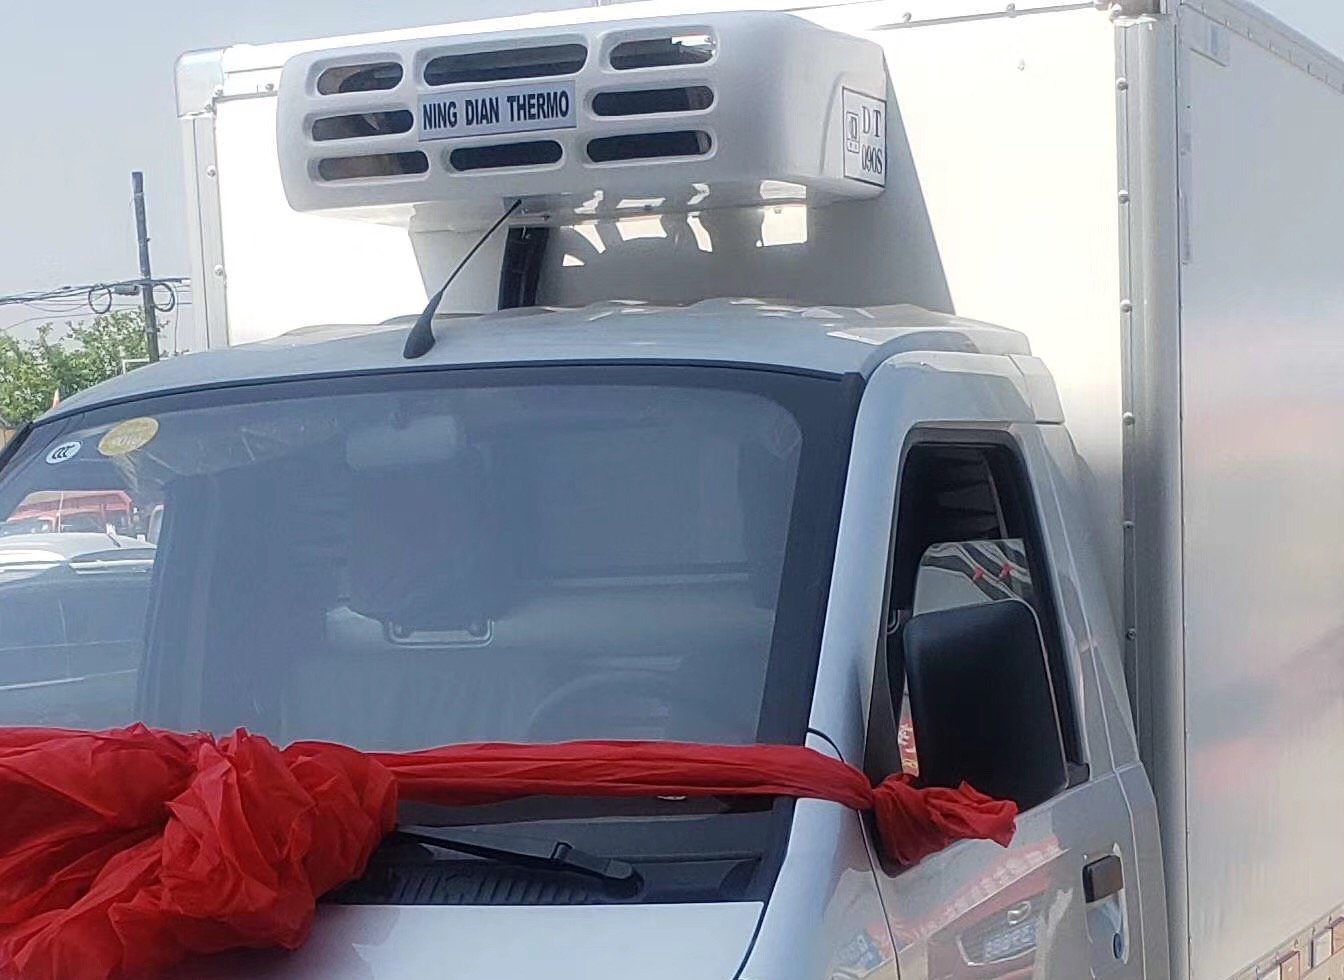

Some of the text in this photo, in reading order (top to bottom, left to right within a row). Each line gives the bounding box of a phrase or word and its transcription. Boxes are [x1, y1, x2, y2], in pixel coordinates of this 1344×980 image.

[423, 90, 569, 130] NING DIAN THERMO
